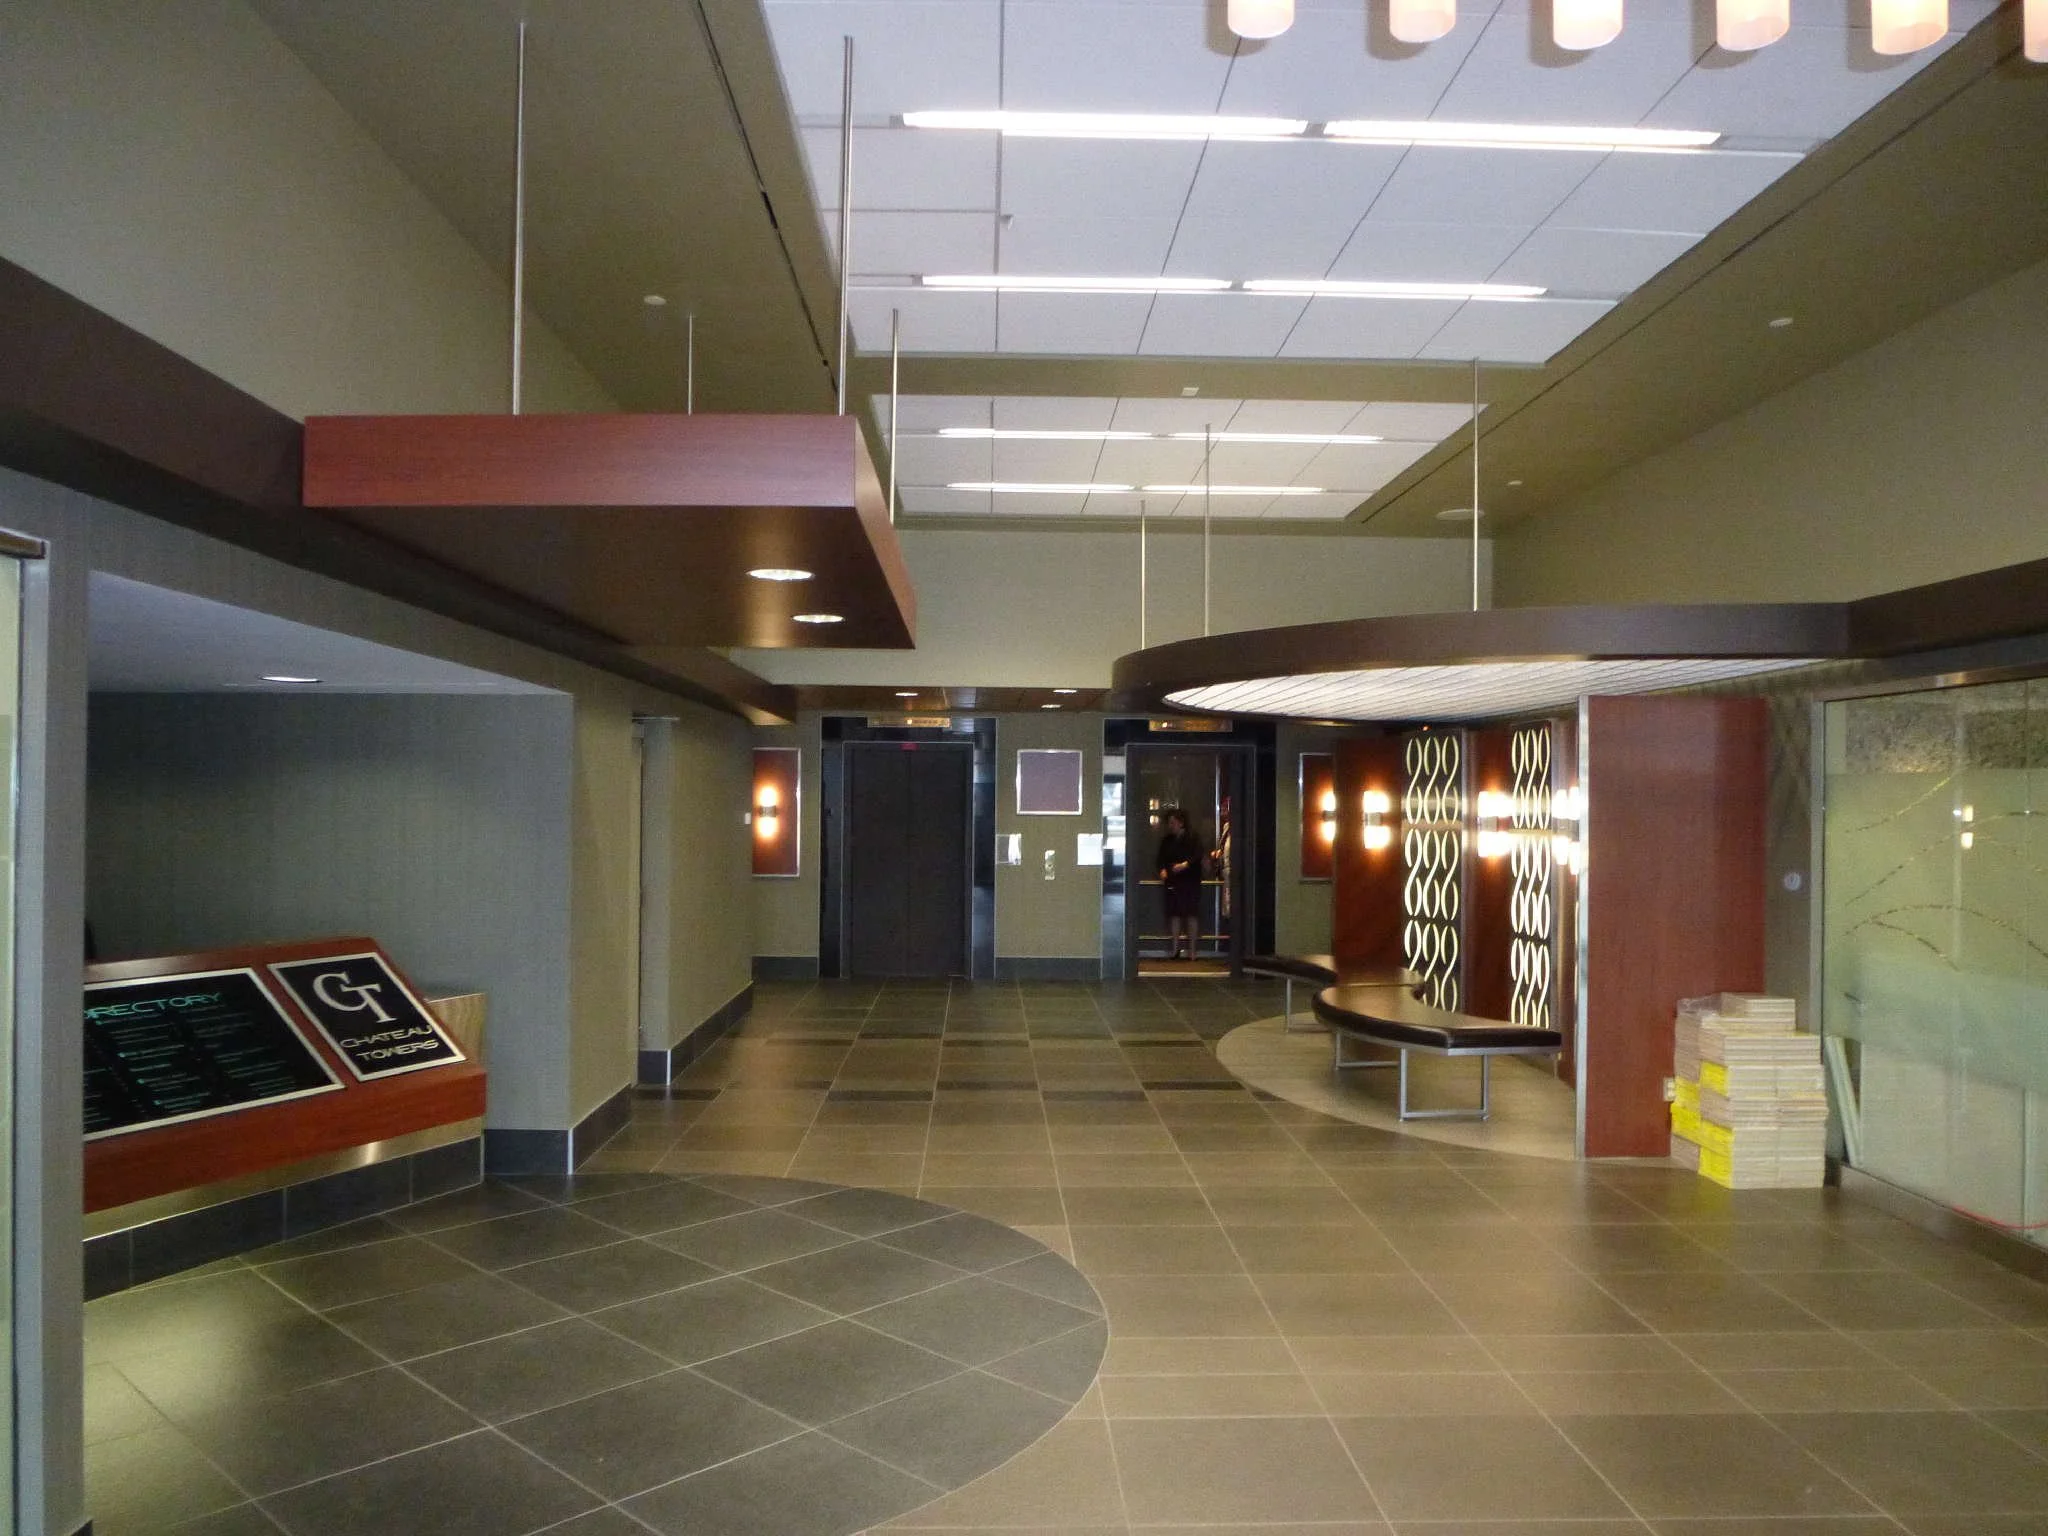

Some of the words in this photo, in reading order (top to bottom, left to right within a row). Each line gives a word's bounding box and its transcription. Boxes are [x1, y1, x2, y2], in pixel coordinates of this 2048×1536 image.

[84, 993, 220, 1018] IRECTORY
[340, 1024, 433, 1048] CHATEAU
[356, 1039, 440, 1060] TOWERS
